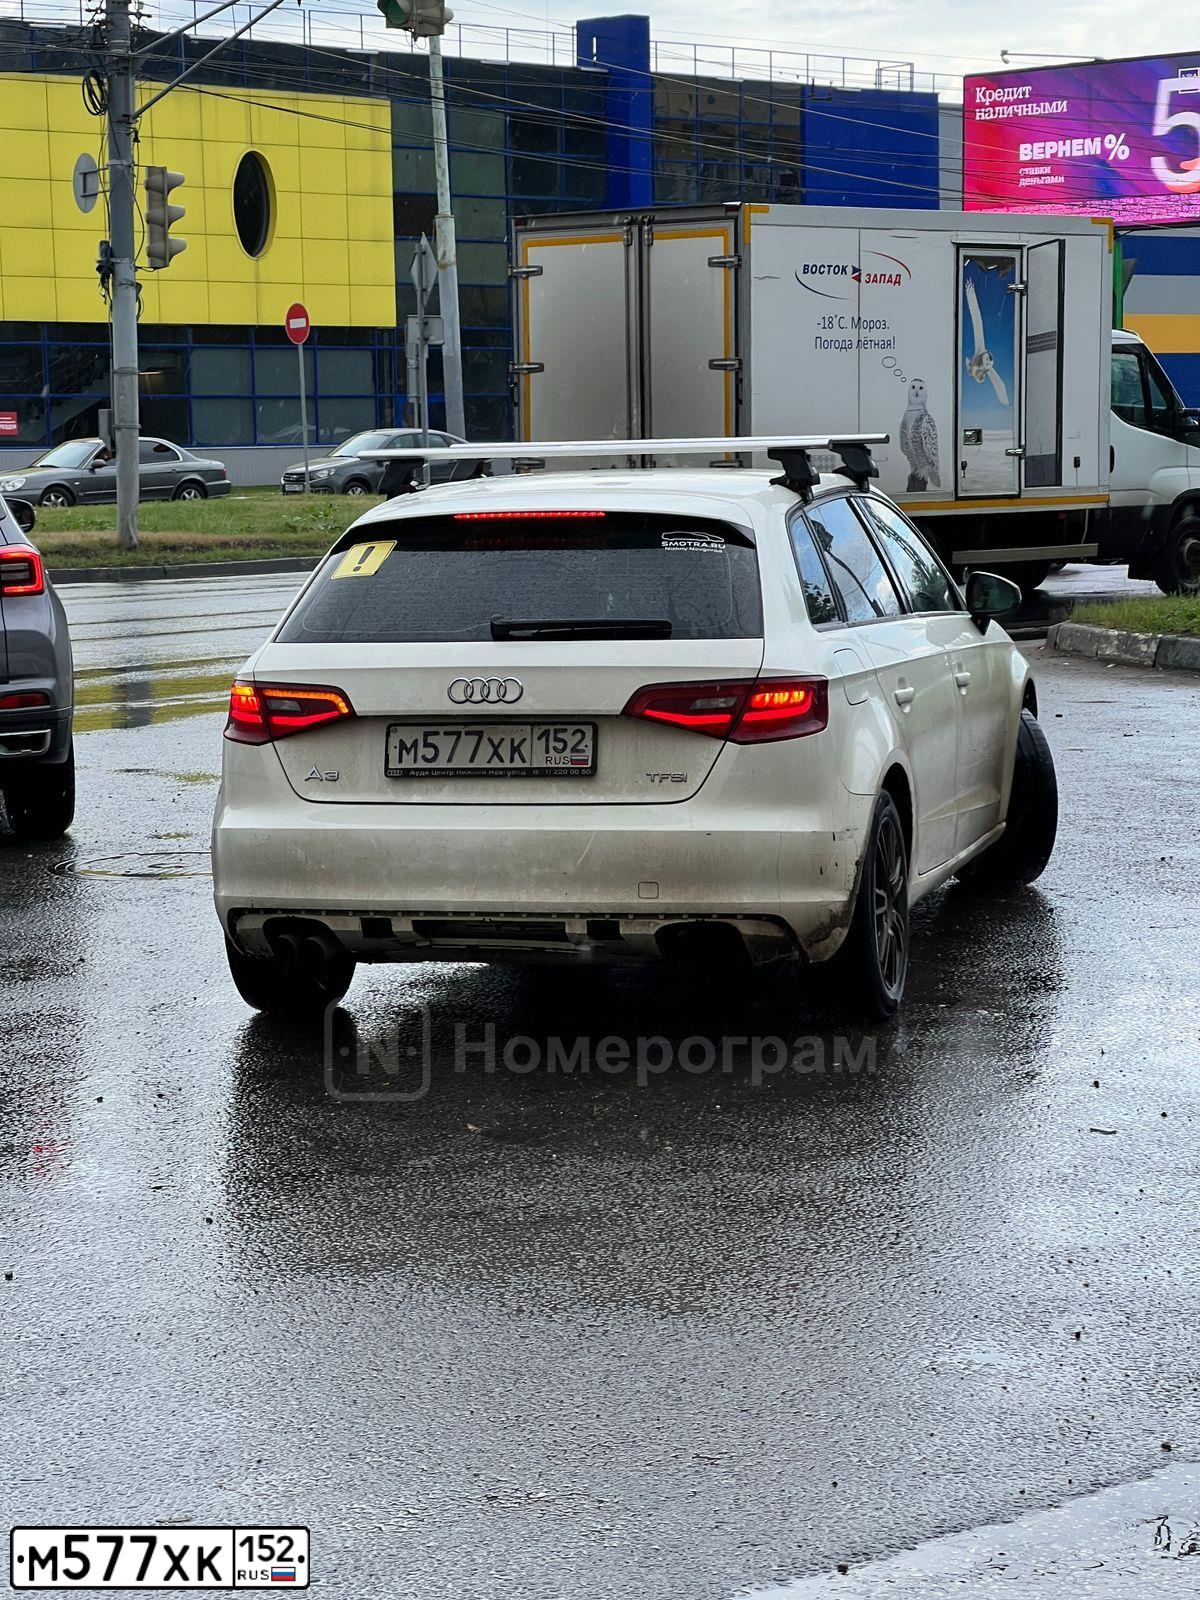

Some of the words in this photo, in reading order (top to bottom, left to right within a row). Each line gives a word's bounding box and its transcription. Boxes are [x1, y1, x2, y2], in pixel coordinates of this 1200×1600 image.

[975, 86, 1032, 104] Кредит
[975, 100, 1068, 120] наличными
[1150, 77, 1200, 186] 5
[1019, 165, 1052, 176] ставки
[1018, 174, 1065, 188] деньгами
[802, 264, 849, 276] ВОСТОК
[864, 273, 902, 287] ЗАПАД
[851, 316, 890, 333] Мороз.
[815, 336, 853, 352] Погода
[856, 336, 896, 350] лётная!
[661, 541, 726, 549] SMOTRA.RU
[537, 727, 586, 755] 152
[545, 756, 570, 765] RUS
[304, 765, 340, 782] A3
[409, 769, 430, 777] Ауди
[645, 771, 688, 783] TFSI
